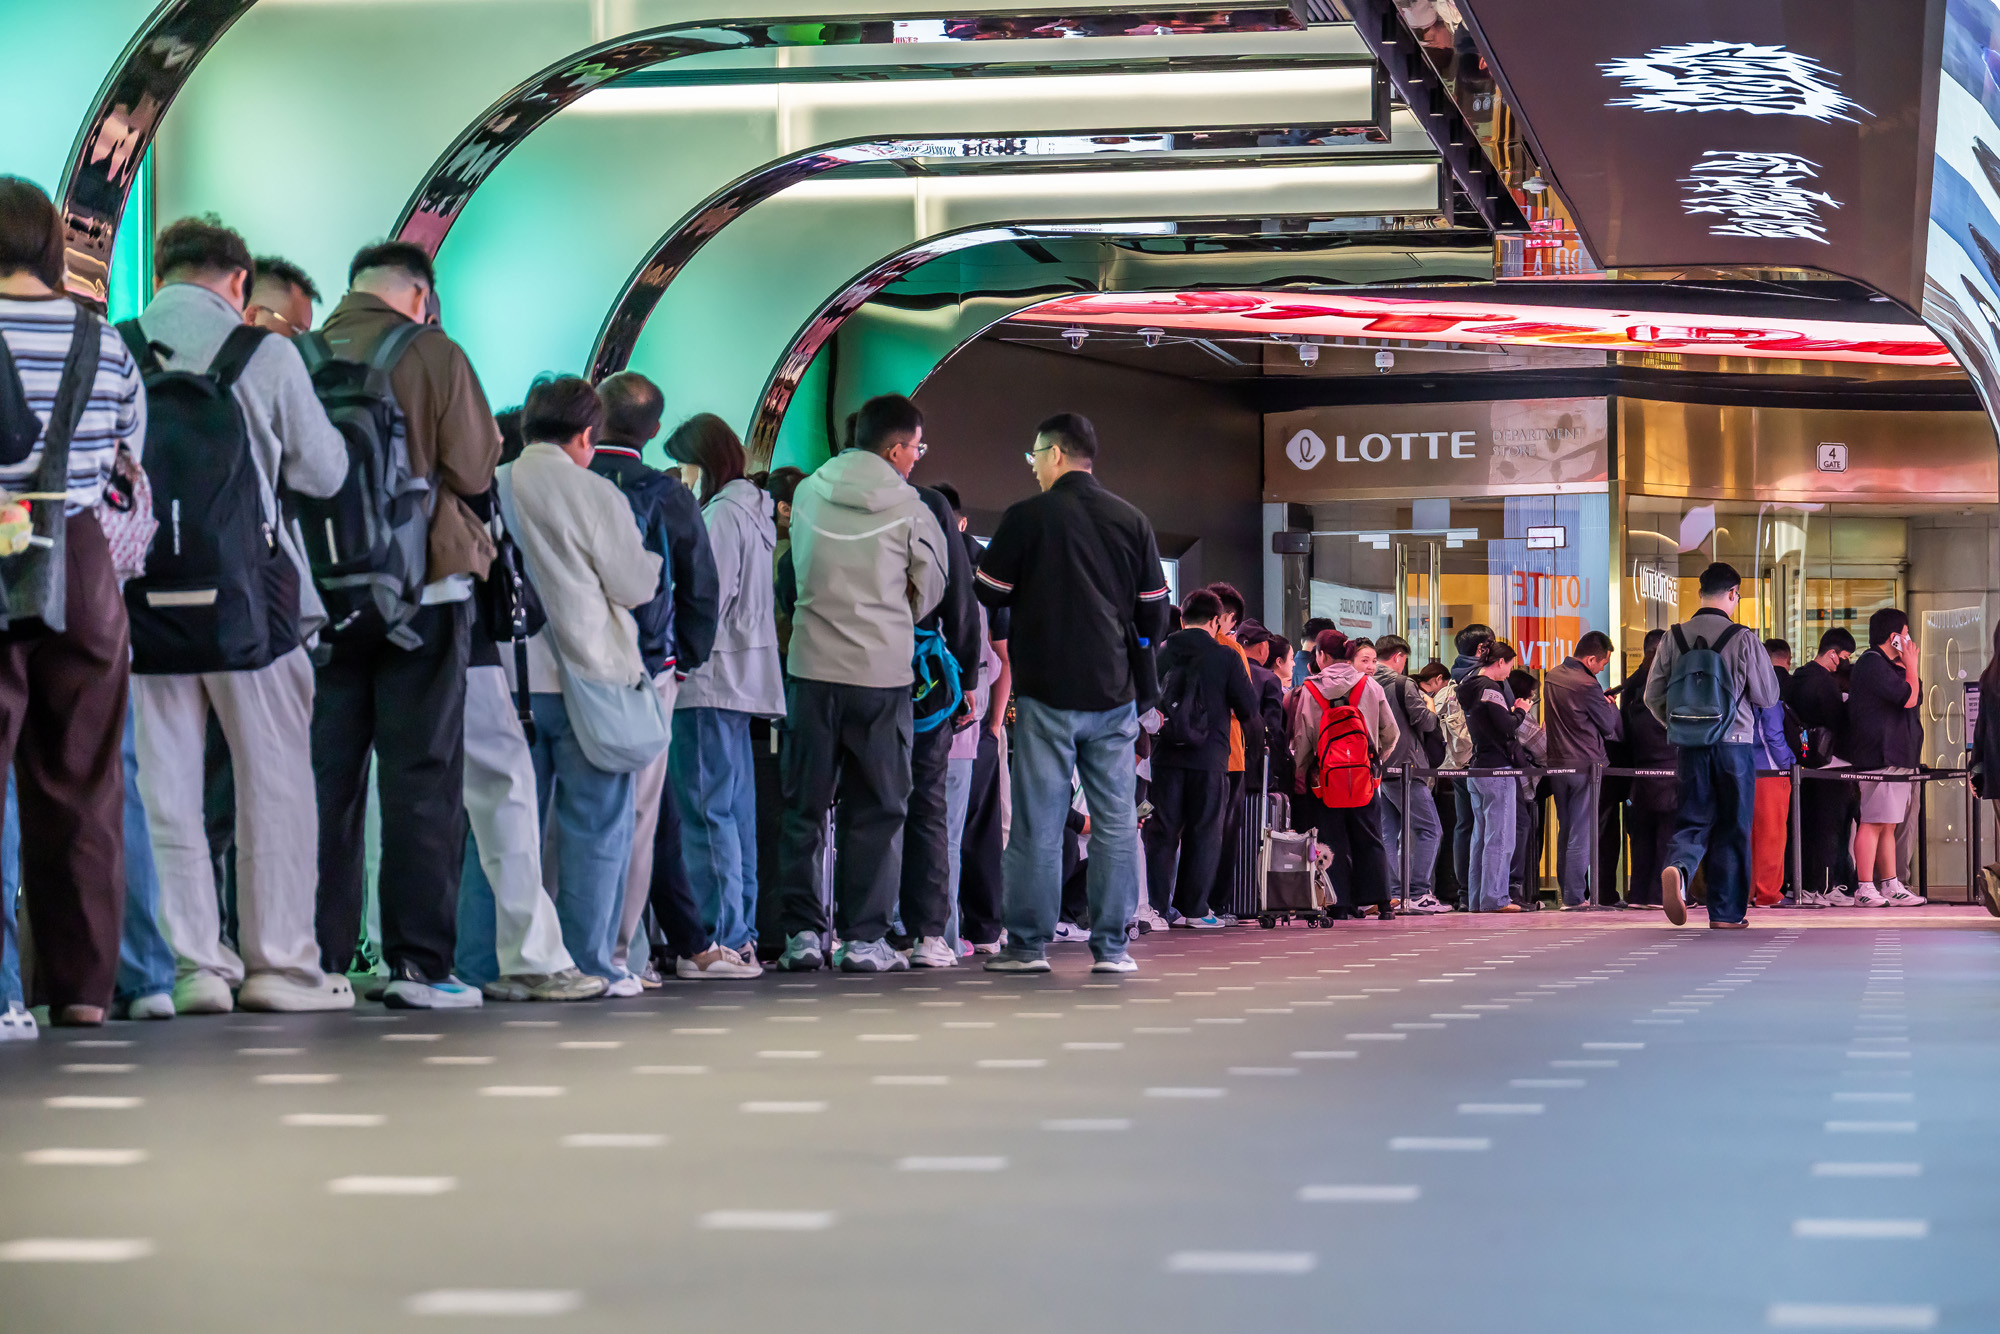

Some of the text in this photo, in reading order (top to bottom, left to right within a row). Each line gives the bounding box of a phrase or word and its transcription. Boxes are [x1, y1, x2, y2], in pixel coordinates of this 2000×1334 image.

[1492, 427, 1585, 441] DEPARTMENT
[1336, 431, 1476, 462] LOTTE
[1492, 444, 1536, 457] STORE
[1829, 448, 1837, 460] 4
[1823, 460, 1841, 469] GATE
